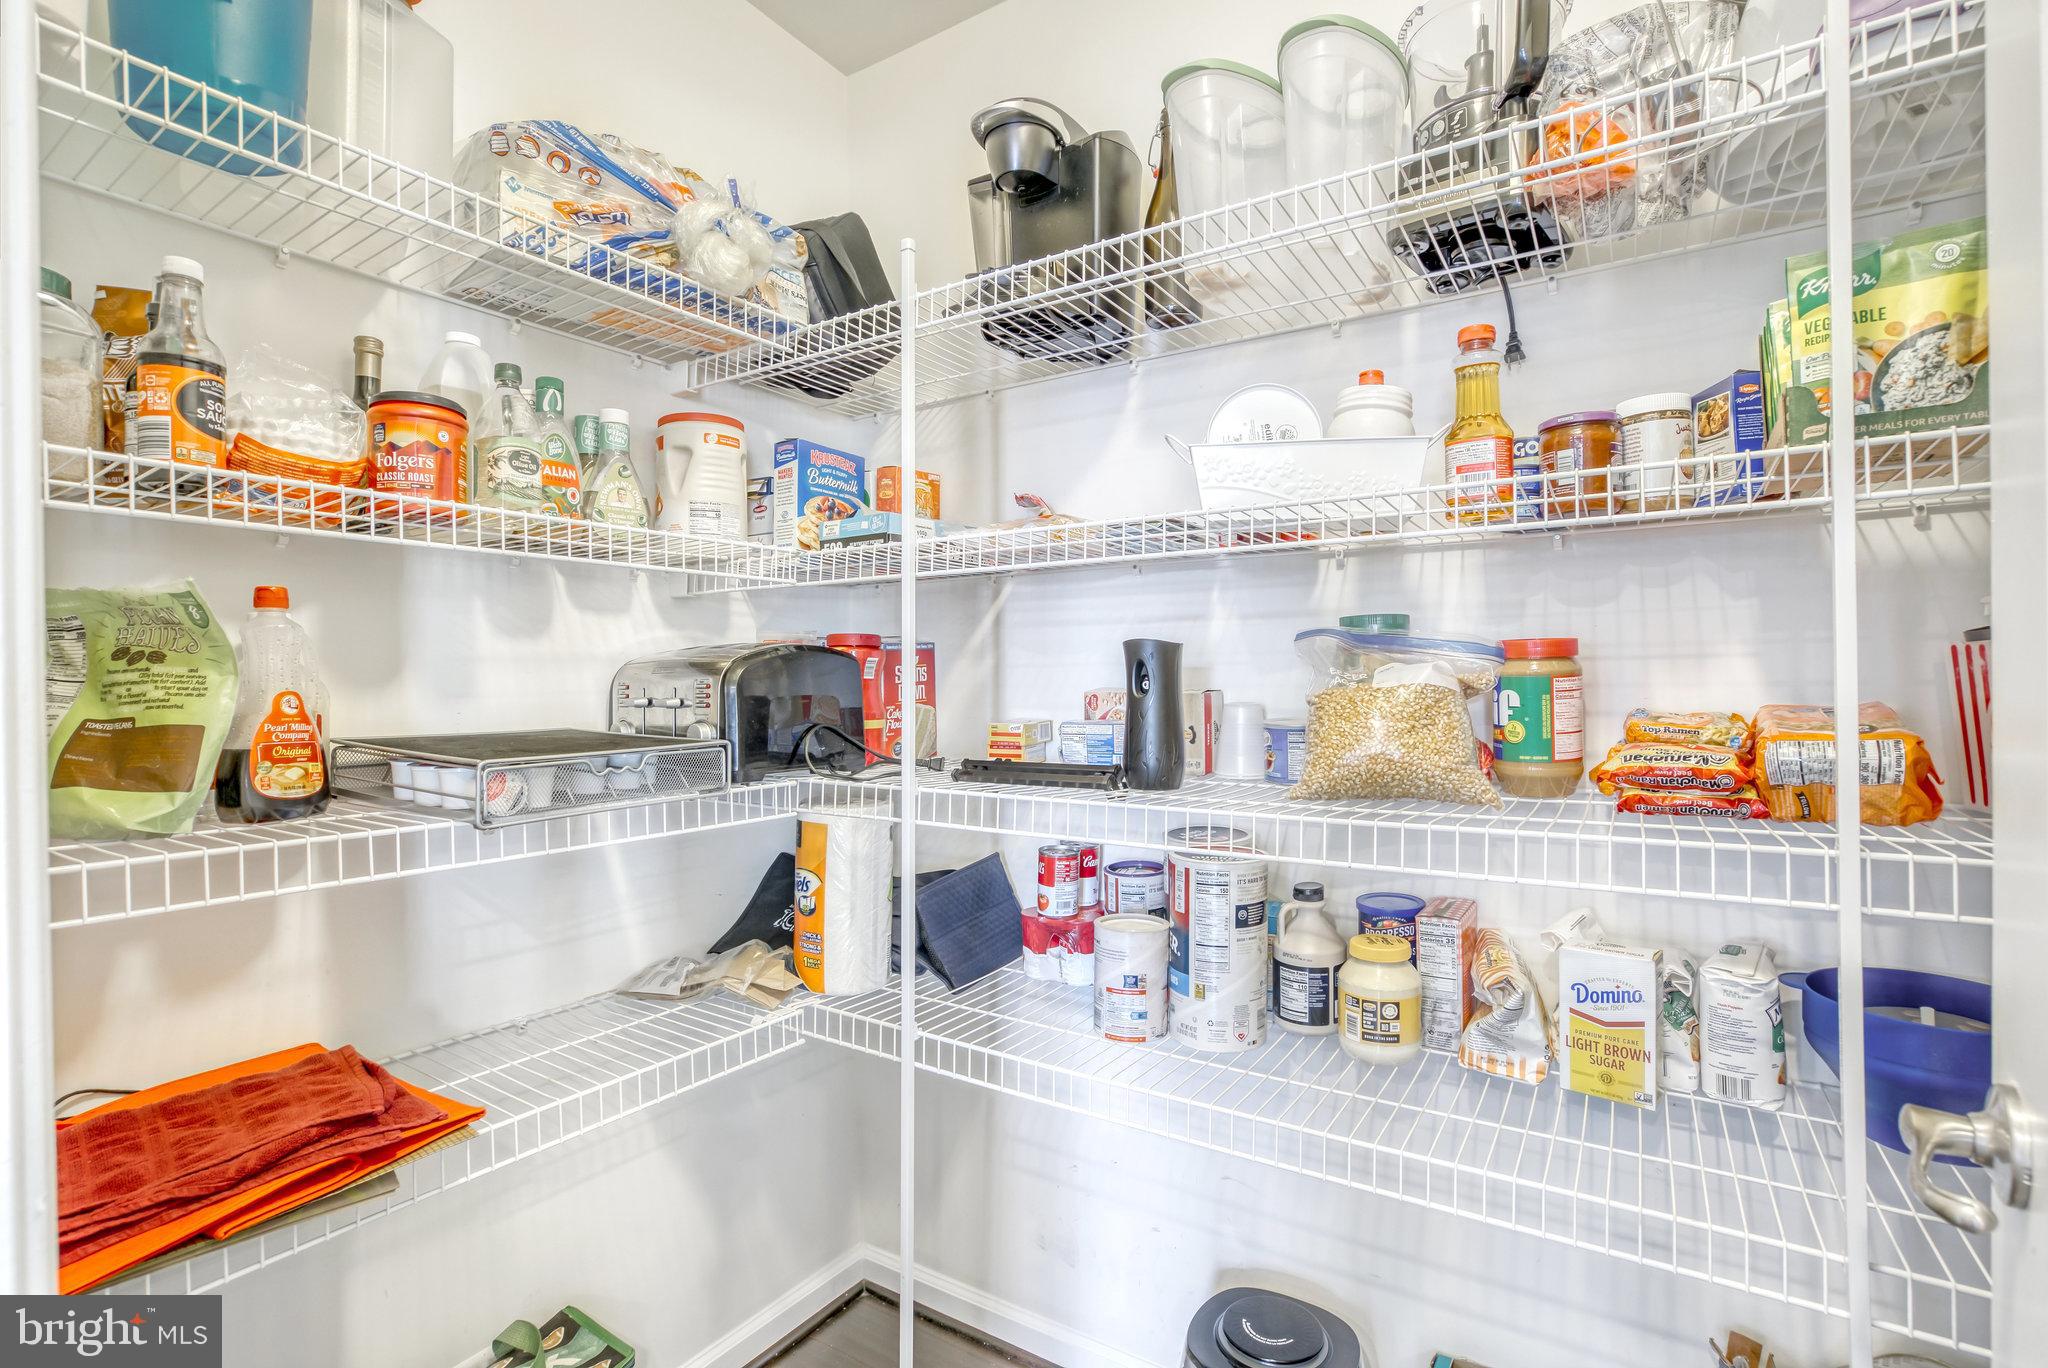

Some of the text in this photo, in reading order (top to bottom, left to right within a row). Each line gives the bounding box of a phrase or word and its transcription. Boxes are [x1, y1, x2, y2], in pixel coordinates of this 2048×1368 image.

[1868, 421, 1903, 433] MEALS
[1905, 418, 1926, 429] FOR
[1927, 414, 1961, 425] EVERY
[376, 452, 435, 471] Folgers
[809, 449, 858, 476] KRUSTEAZ
[376, 471, 435, 482] CLASSIC ROAST
[807, 467, 859, 494] Buttermilk
[114, 626, 201, 654] HALVES
[264, 723, 313, 734] Pearl Milling
[271, 731, 310, 742] Company
[1641, 725, 1700, 735] Top Ramen
[272, 745, 312, 759] Original
[1622, 752, 1710, 766] Maruchan
[1893, 739, 1903, 769] Nutrition
[1660, 775, 1721, 789] Maruchan
[1419, 920, 1441, 928] Nutrition
[1419, 936, 1456, 945] Calories 35
[1570, 982, 1643, 1004] Domino
[1574, 1028, 1640, 1046] PREMIUM PURE CANE
[1565, 1034, 1651, 1064] LIGHT BROWN
[1589, 1054, 1626, 1072] SUGAR
